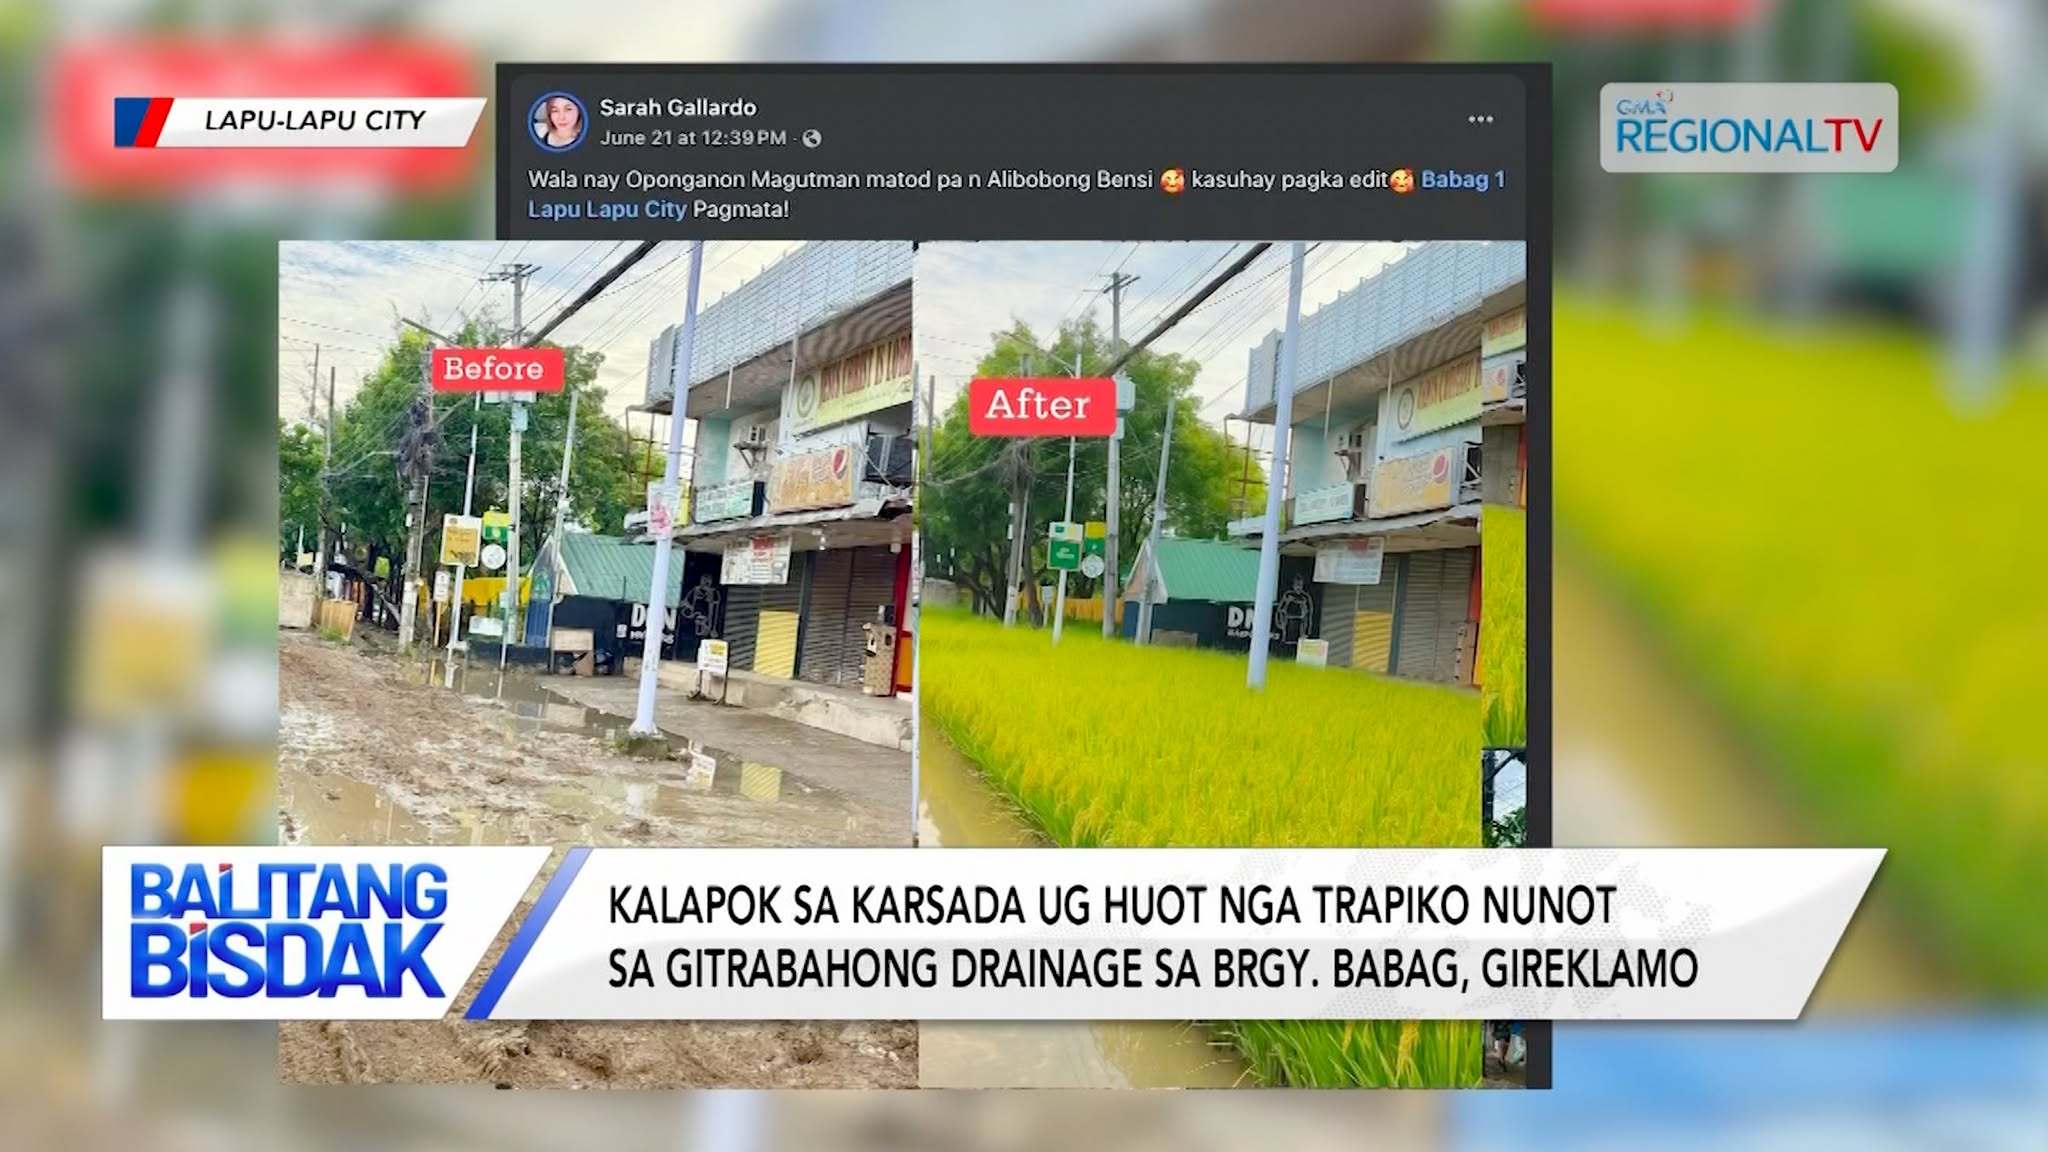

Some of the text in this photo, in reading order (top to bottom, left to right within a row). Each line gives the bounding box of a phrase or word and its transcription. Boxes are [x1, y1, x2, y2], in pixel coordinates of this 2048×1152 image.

[600, 98, 757, 117] Sarah Gallardo
[600, 130, 787, 146] June 21 at 12:39 PM
[528, 170, 1504, 193] Wala nay Oponganon Magutman matod pa n Alibobong Bensi kasuhay pagka edit Babag 1
[528, 200, 789, 222] Lapu Lapu City Pagmata!
